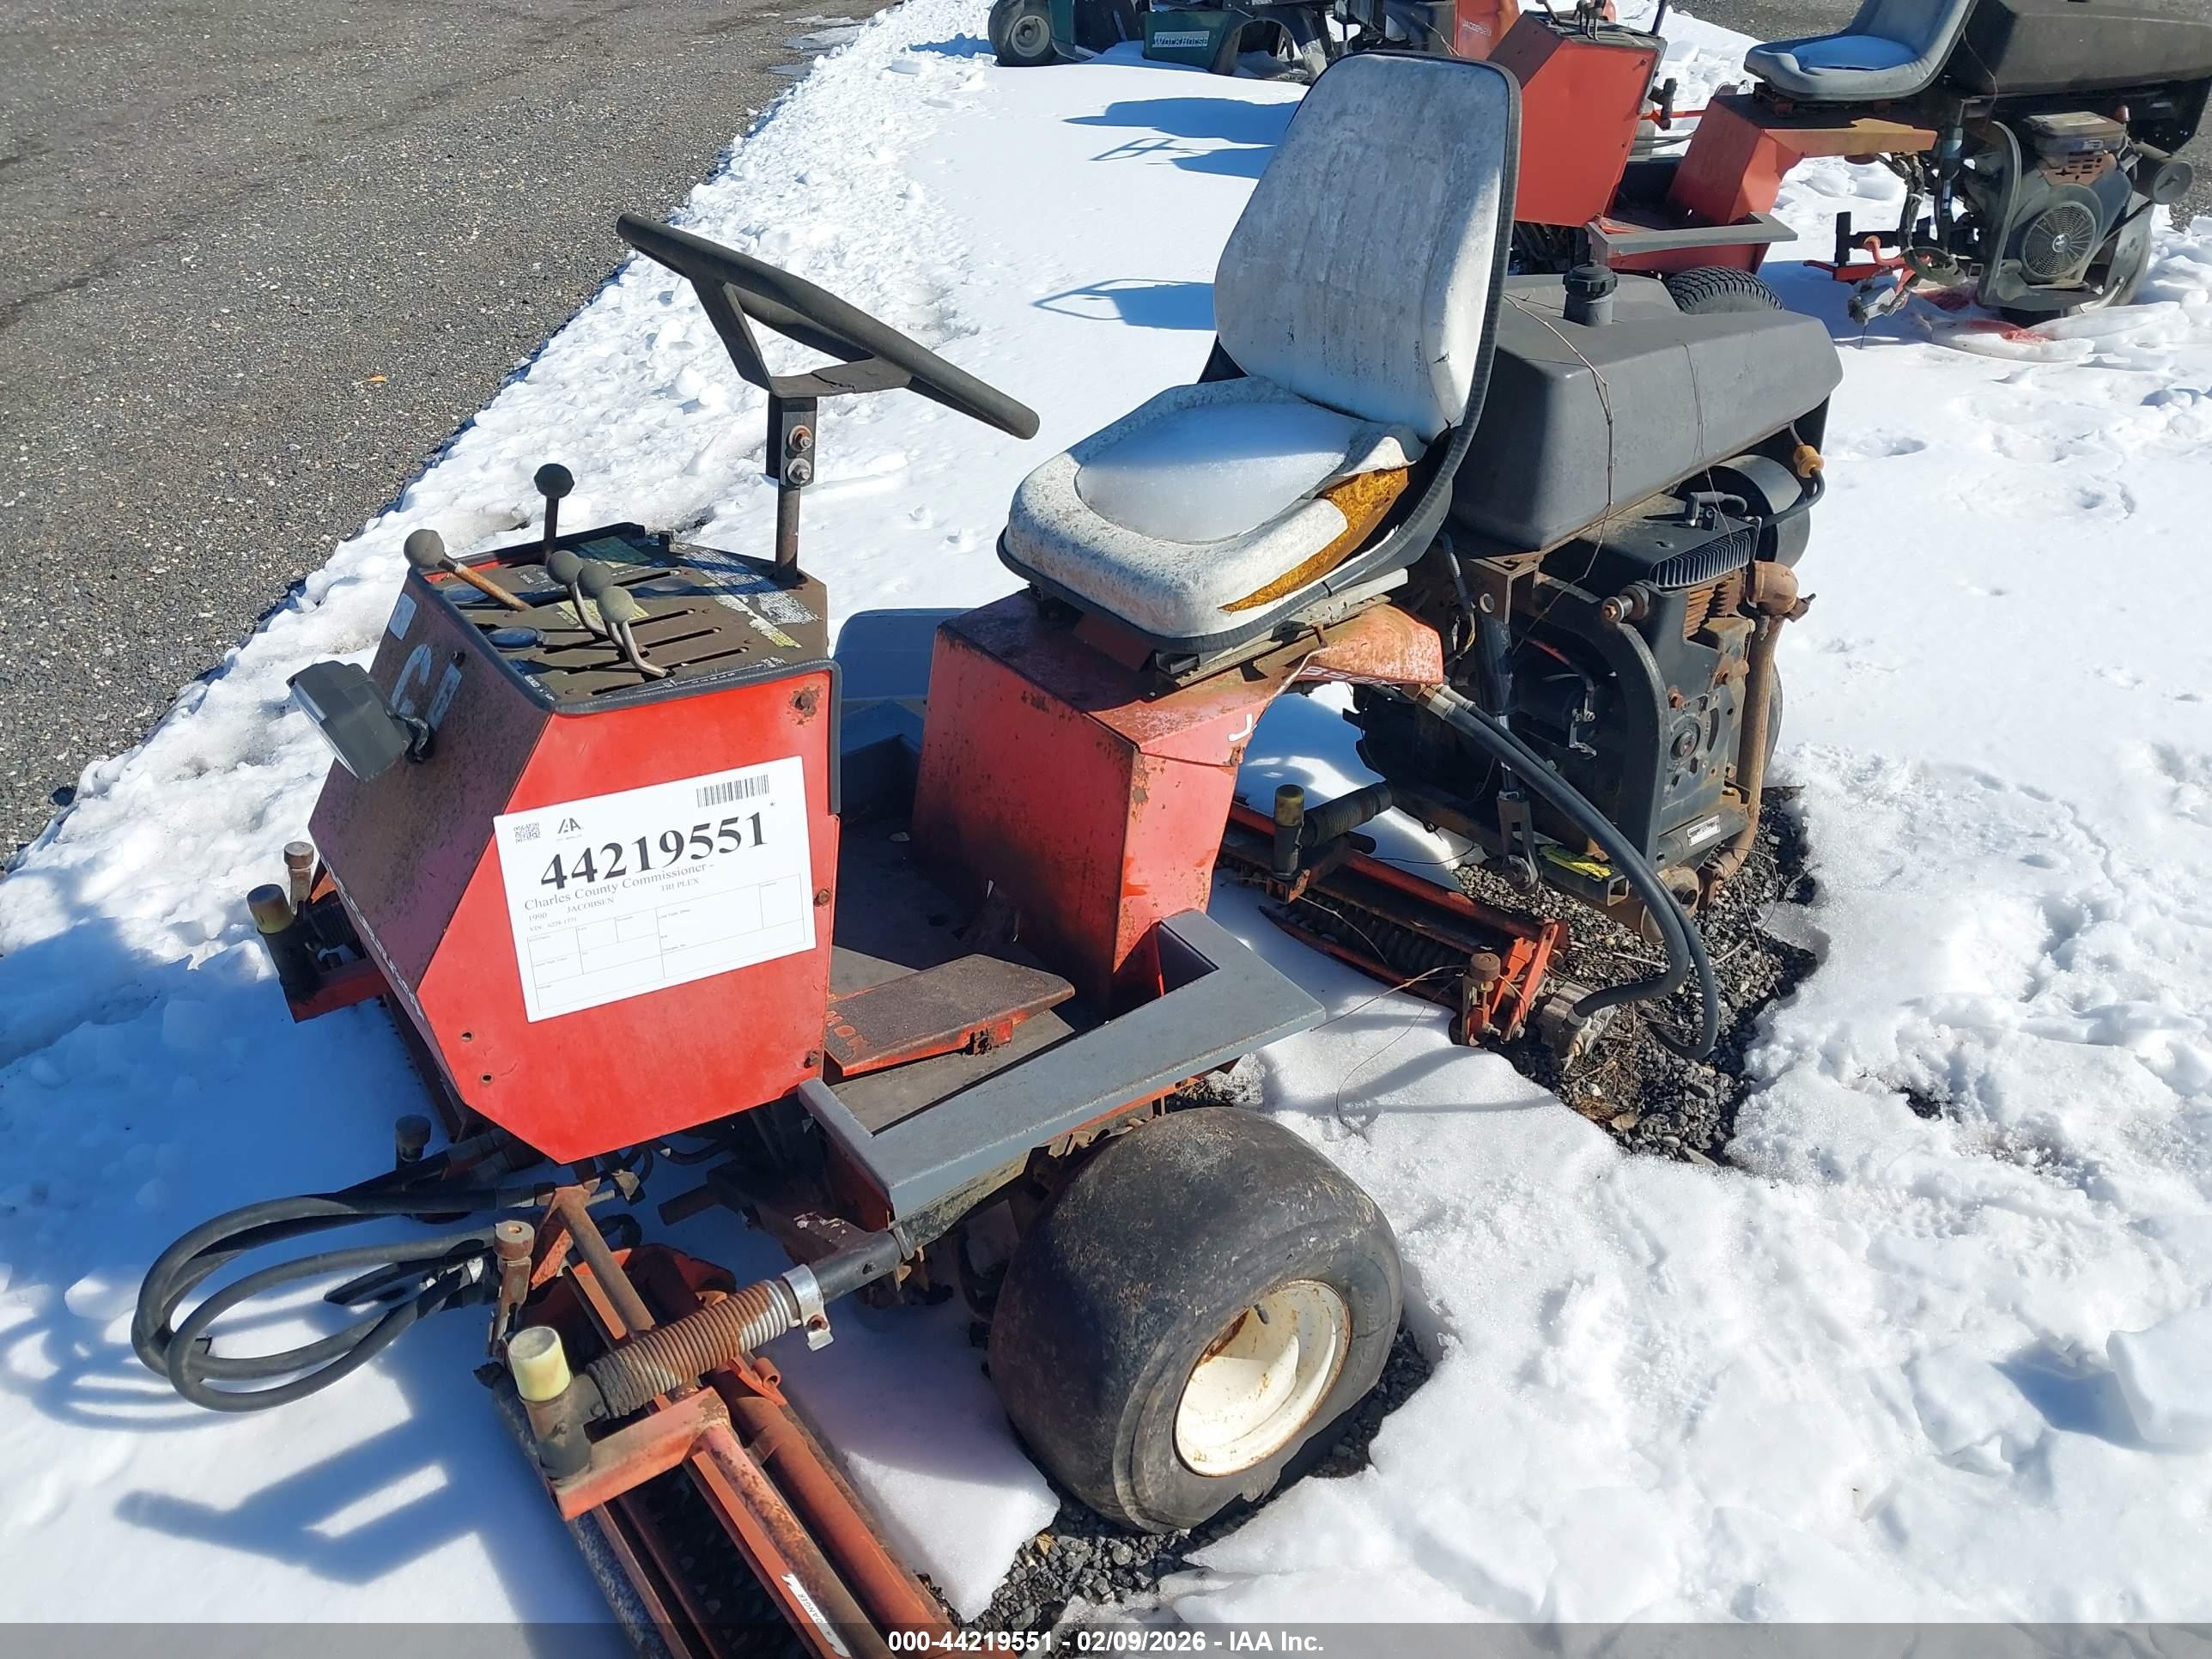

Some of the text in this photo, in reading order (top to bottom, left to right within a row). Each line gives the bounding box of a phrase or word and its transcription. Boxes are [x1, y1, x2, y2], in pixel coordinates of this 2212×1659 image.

[541, 811, 768, 890] 44219551
[525, 888, 571, 911] Charles
[574, 882, 618, 900] County
[622, 863, 708, 889] Commissioner
[528, 912, 548, 921] 1990
[567, 896, 614, 914] JACOBSEN
[678, 878, 700, 889] PLEX
[799, 1593, 823, 1623] DANGER
